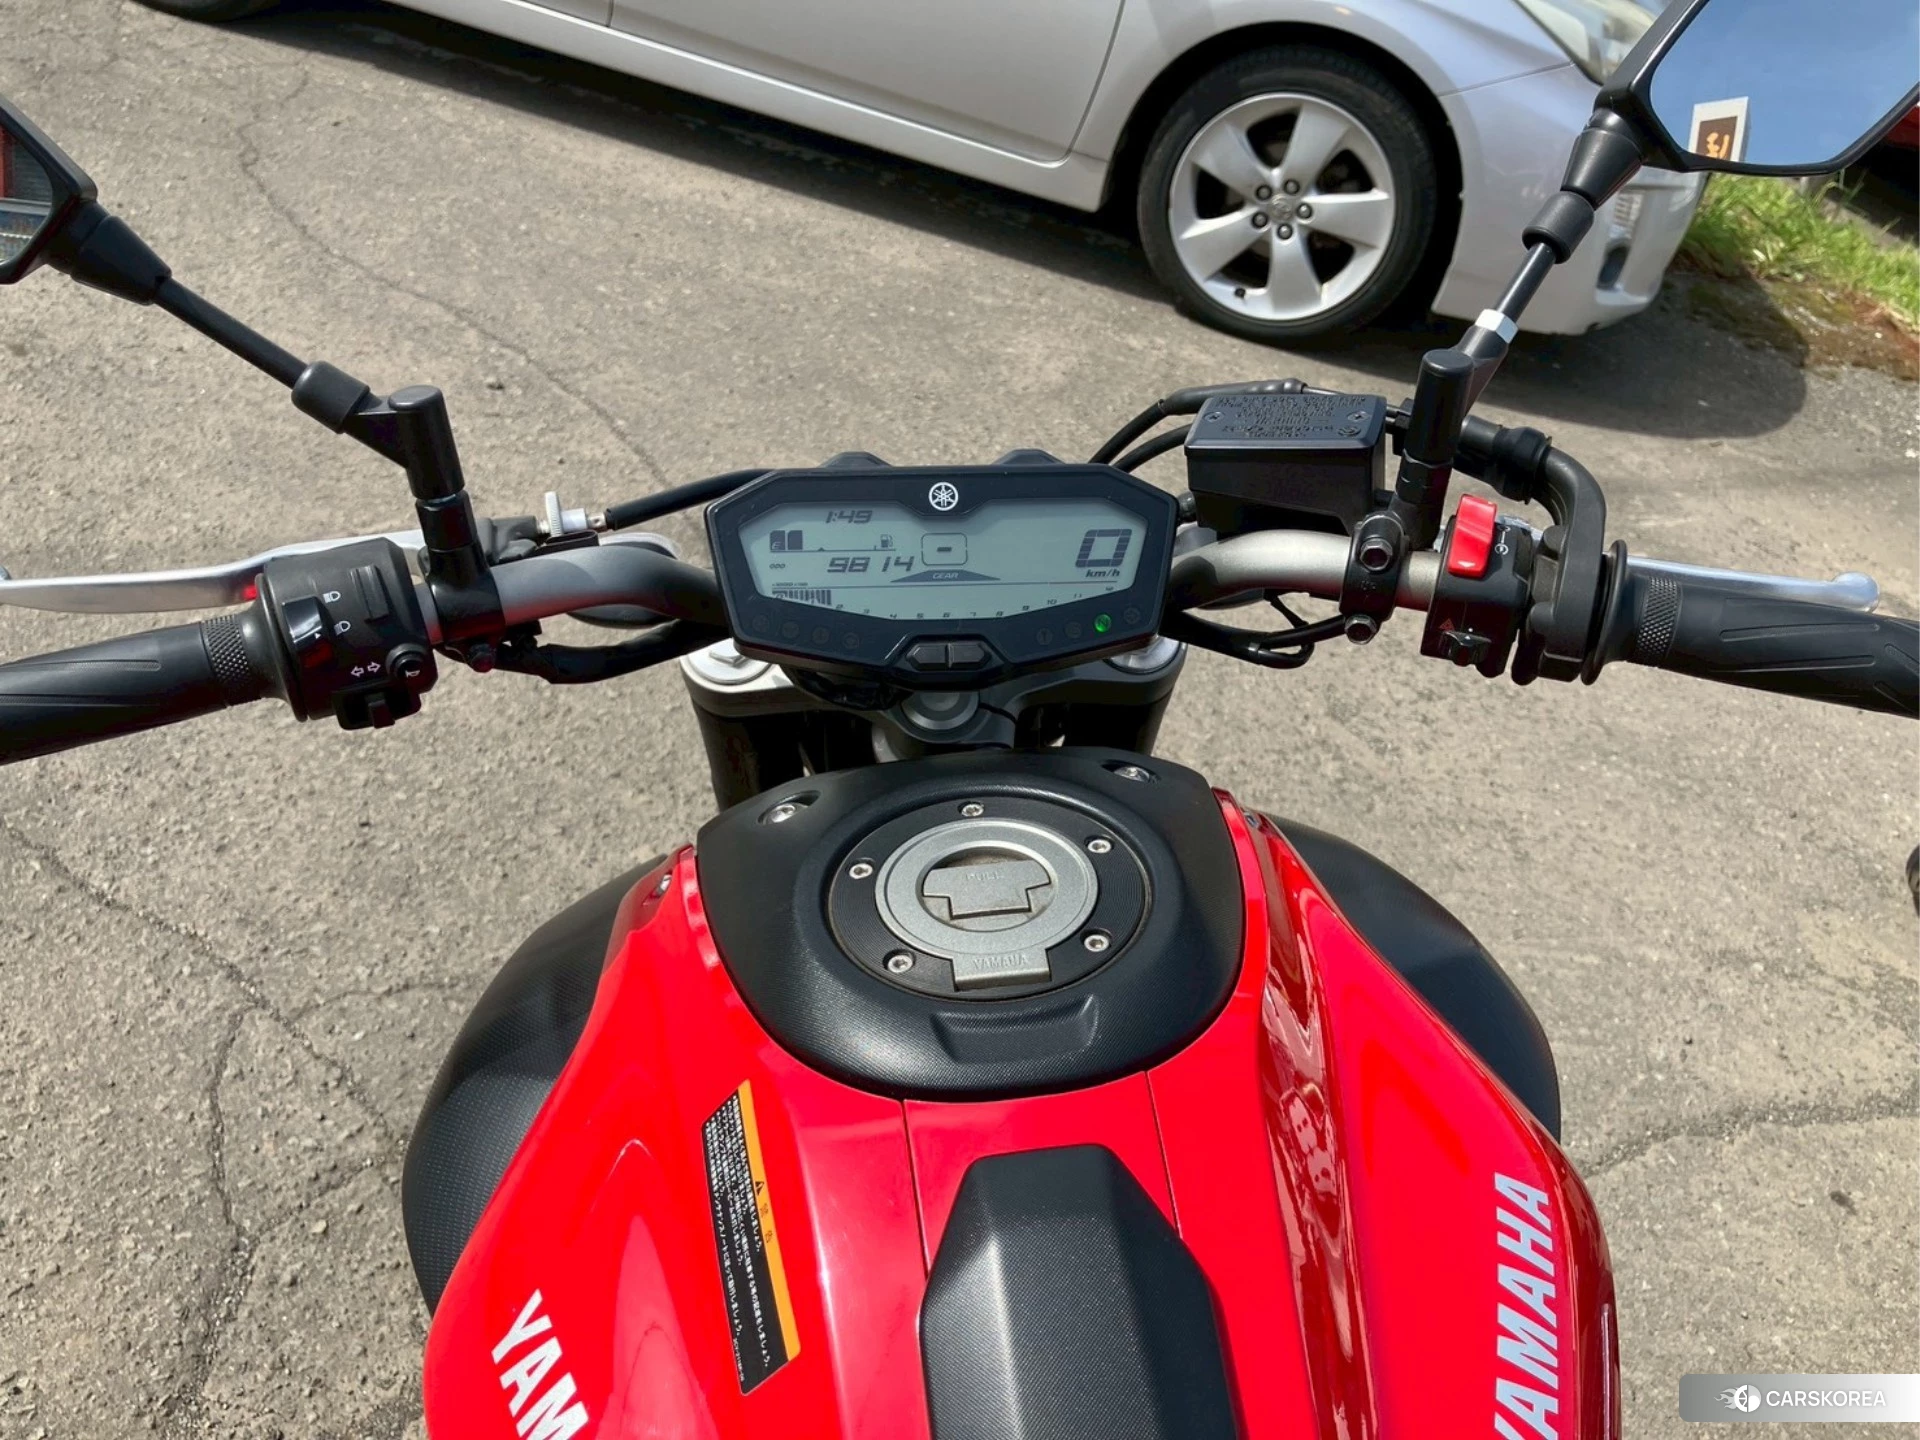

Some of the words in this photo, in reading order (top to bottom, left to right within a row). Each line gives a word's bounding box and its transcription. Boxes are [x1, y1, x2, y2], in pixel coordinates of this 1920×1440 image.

[825, 509, 873, 524] 1:49
[1075, 528, 1132, 568] 0
[827, 556, 915, 573] 9814
[932, 572, 959, 580] GEAR
[1085, 569, 1121, 578] km/h
